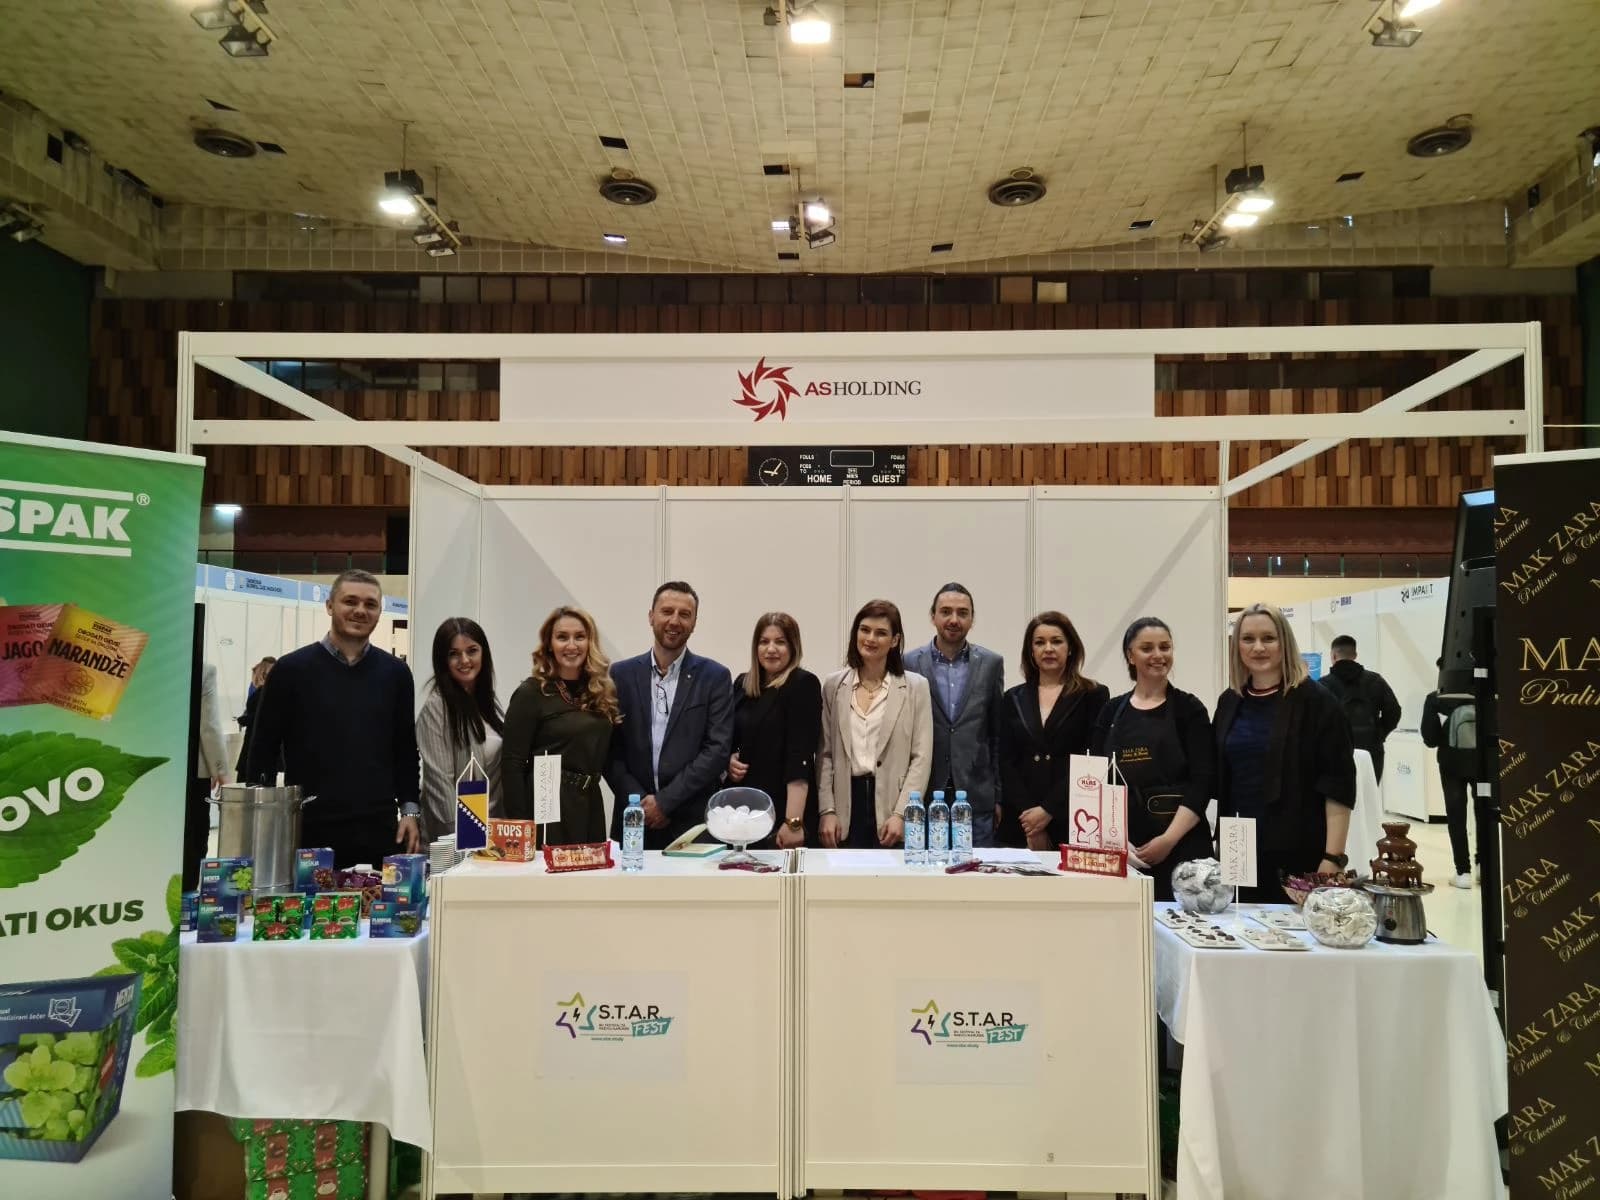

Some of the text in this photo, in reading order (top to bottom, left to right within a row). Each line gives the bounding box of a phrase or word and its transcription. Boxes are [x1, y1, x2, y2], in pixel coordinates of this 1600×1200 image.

[807, 474, 833, 483] HOME
[872, 474, 901, 484] GUEST
[1499, 501, 1600, 594] MAK ZARA
[1517, 570, 1558, 604] Pralines
[48, 638, 130, 679] NARANDŽE
[1500, 783, 1551, 827] MAK
[1545, 740, 1600, 789] ZARA
[496, 823, 522, 837] TOPS
[1084, 858, 1107, 868] Lokum
[1503, 858, 1560, 904] ZARA
[1525, 873, 1570, 905] Chocolate
[45, 900, 145, 931] OKUS
[1540, 906, 1596, 950] MAK
[1542, 982, 1600, 1028] ZARA
[634, 1021, 668, 1034] FEST
[988, 1028, 1022, 1042] FEST
[1523, 1114, 1568, 1144] Chocolate
[1537, 1148, 1591, 1190] MAK
